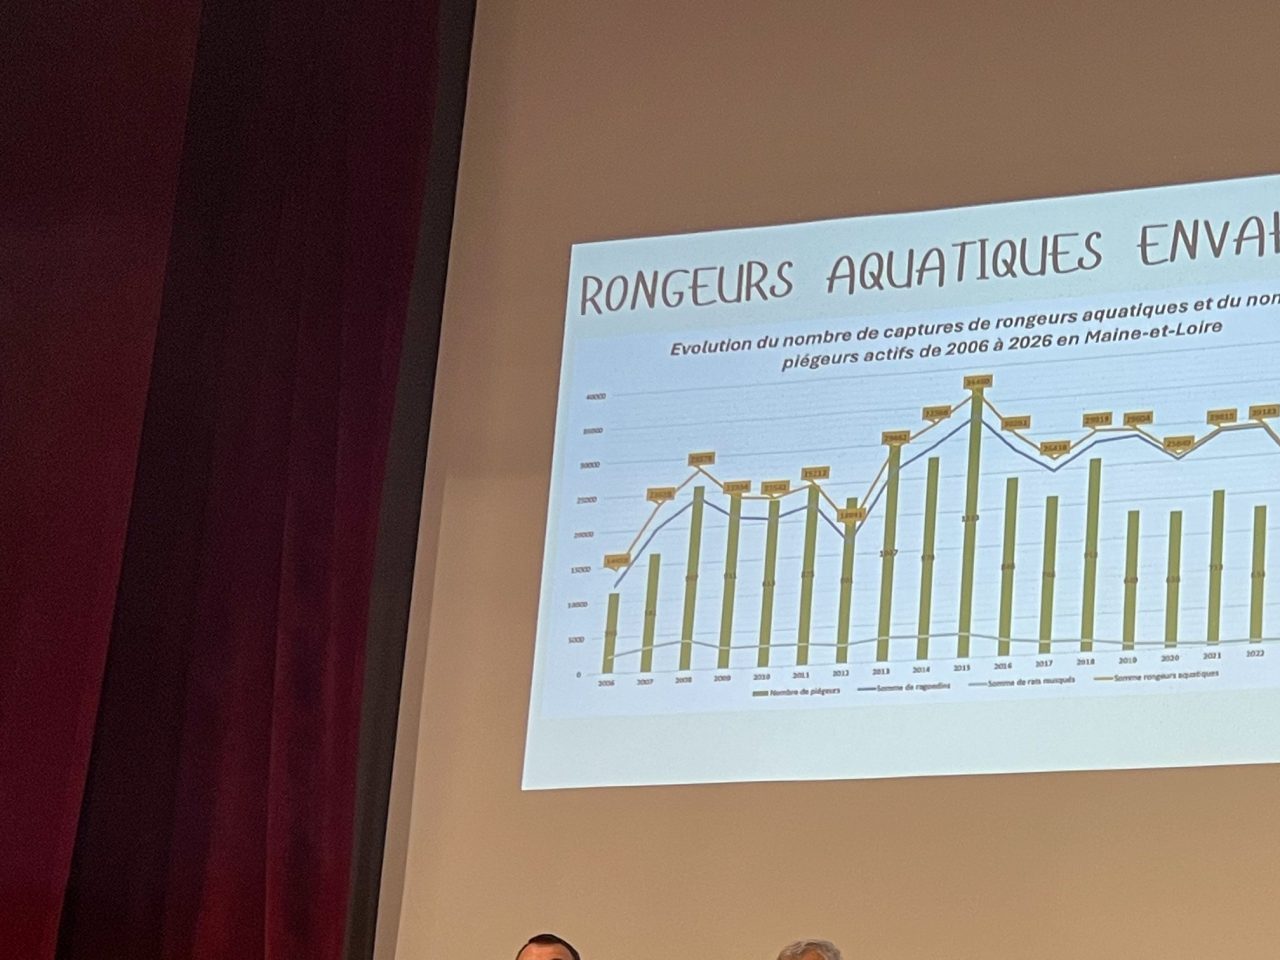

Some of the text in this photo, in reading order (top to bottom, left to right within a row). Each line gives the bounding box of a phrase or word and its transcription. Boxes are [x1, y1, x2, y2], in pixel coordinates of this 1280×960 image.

[580, 260, 794, 316] RONGEURS
[826, 231, 1102, 296] AQUATIQUES
[670, 338, 752, 356] Evolution
[756, 335, 780, 349] du
[782, 329, 852, 348] nombre
[856, 326, 879, 341] de
[883, 321, 964, 340] captures
[967, 317, 991, 332] de
[995, 312, 1078, 330] rongeurs
[1081, 302, 1189, 323] aquatiques
[1193, 297, 1214, 312] et
[1216, 294, 1242, 310] du
[781, 320, 1223, 373] piégeurs actifs de 2006 à 2026 en Maine-et-Loire
